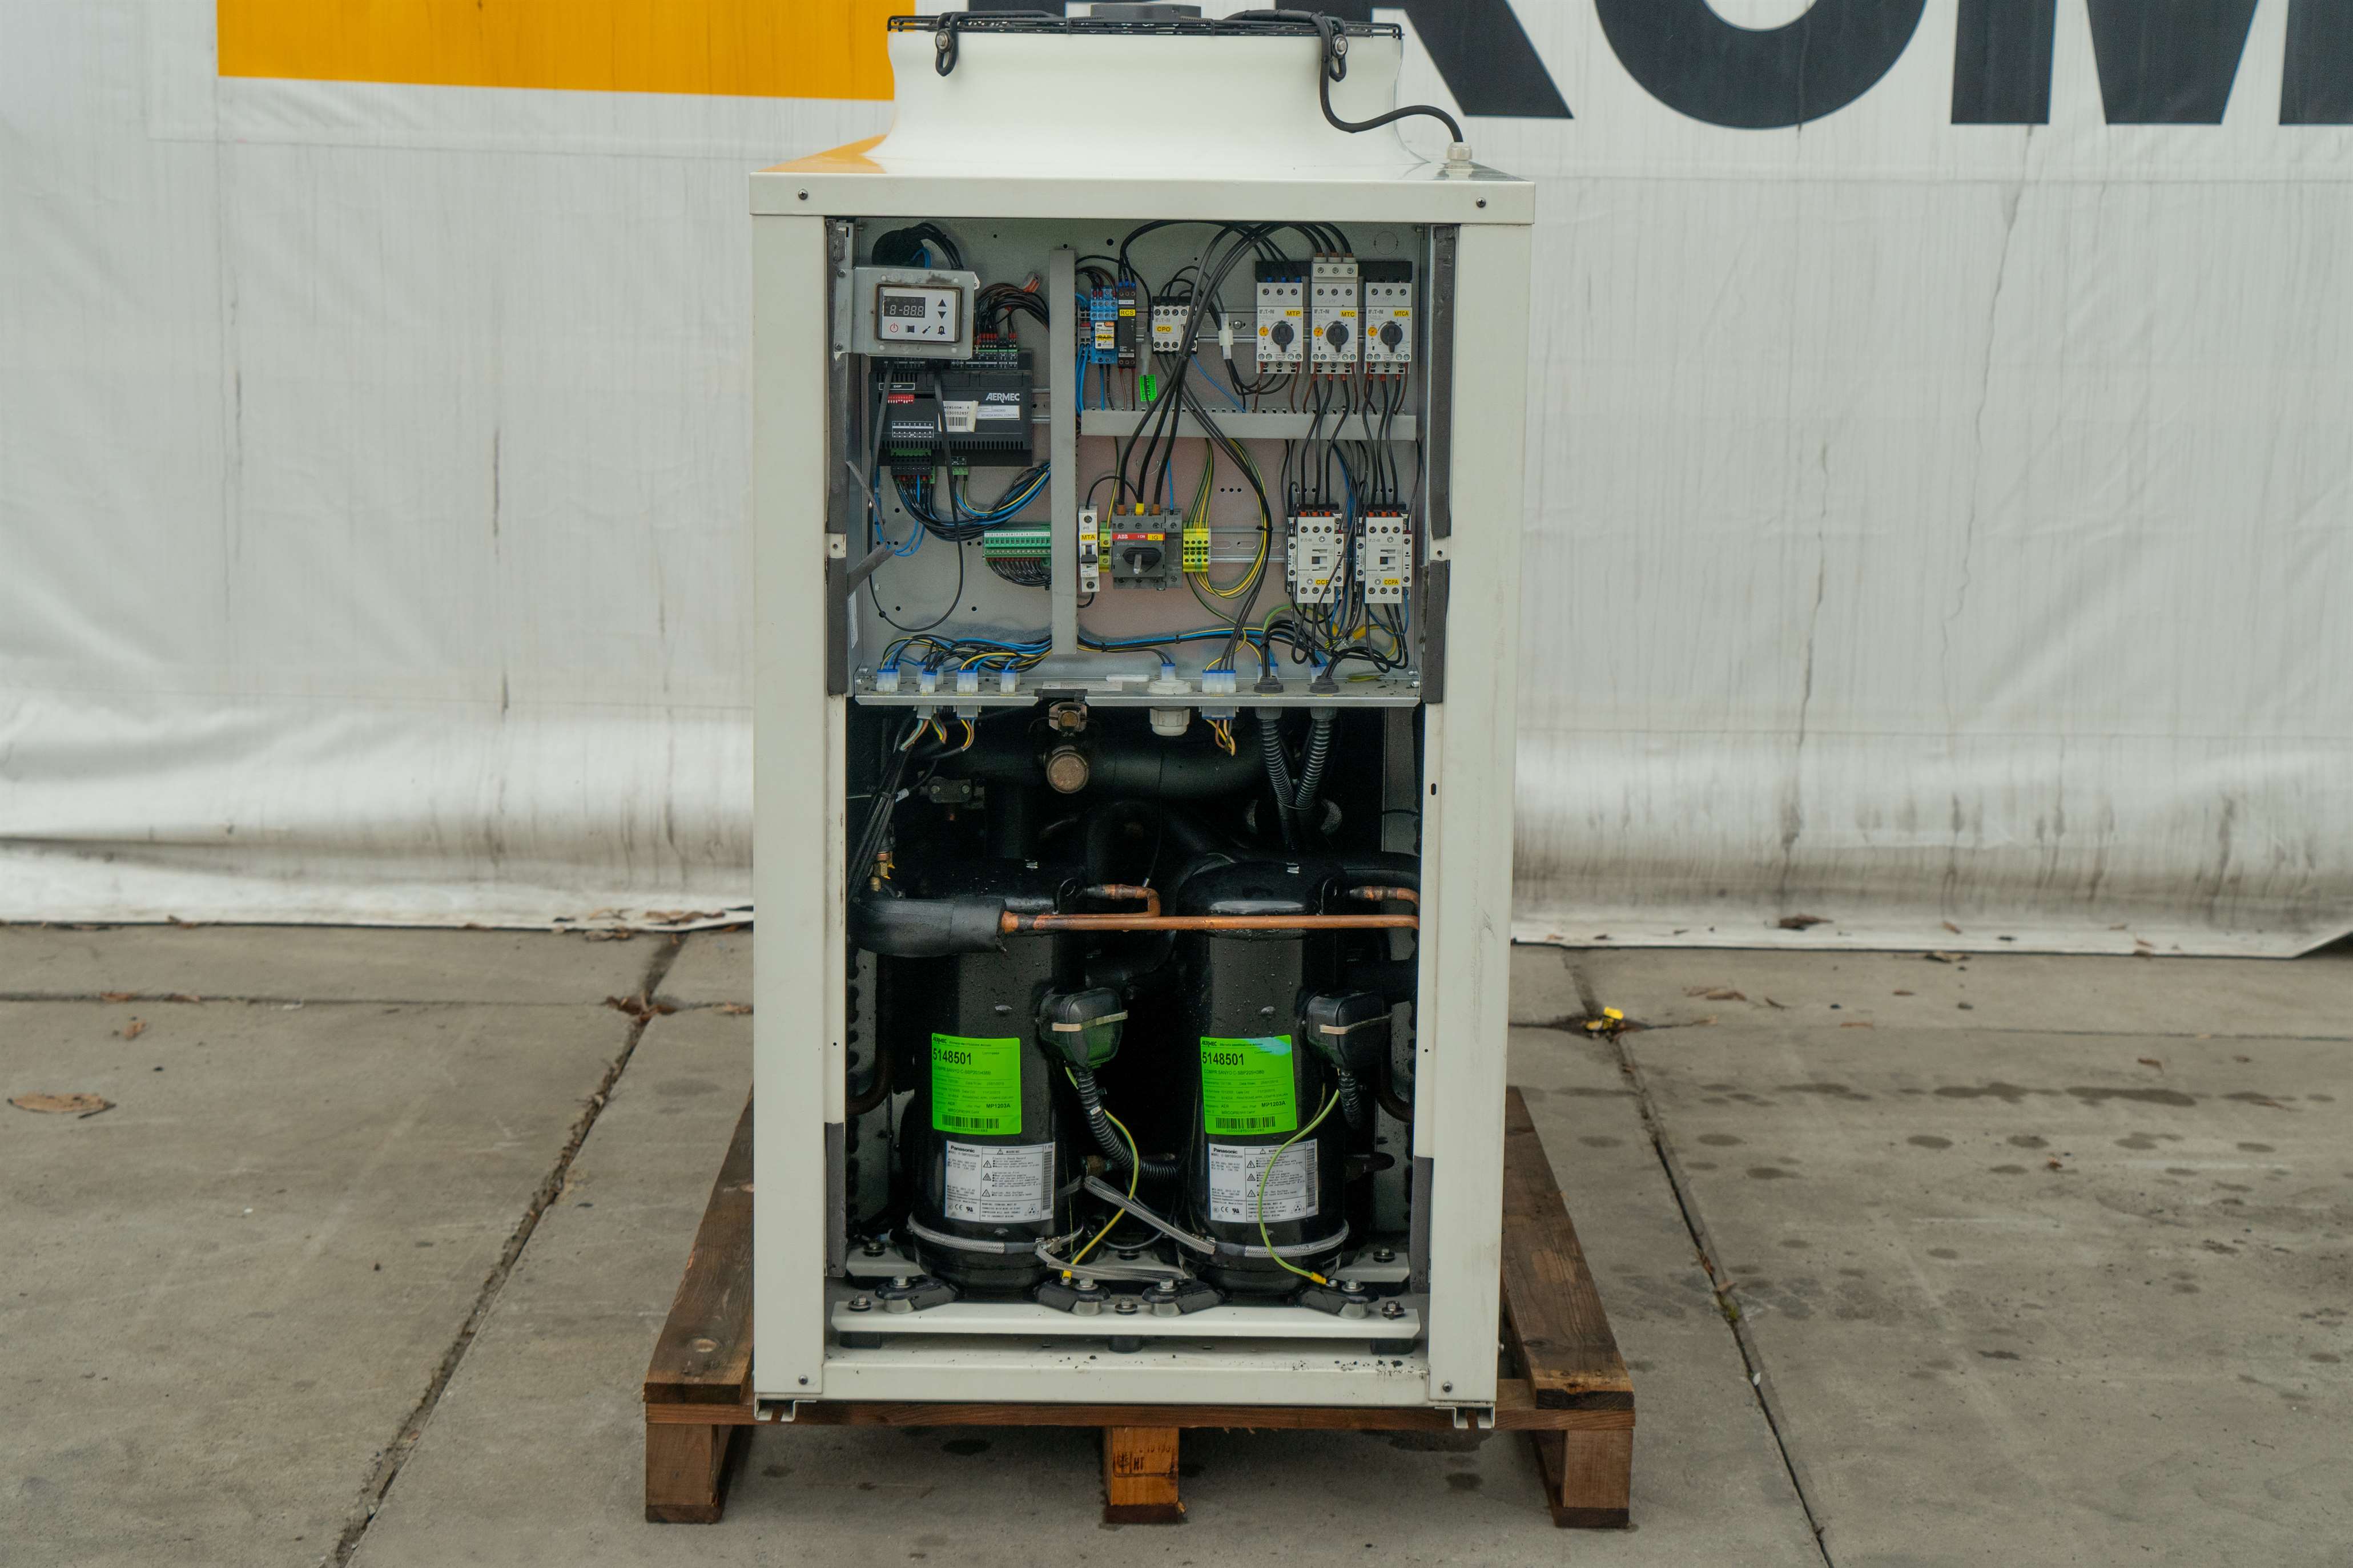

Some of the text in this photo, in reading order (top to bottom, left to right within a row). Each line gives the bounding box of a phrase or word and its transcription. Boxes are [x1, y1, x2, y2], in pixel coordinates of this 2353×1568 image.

[986, 392, 1020, 403] AERMEC
[933, 1047, 972, 1065] 5148501
[1202, 1051, 1244, 1066] 5148501
[951, 1145, 975, 1154] Panasonic
